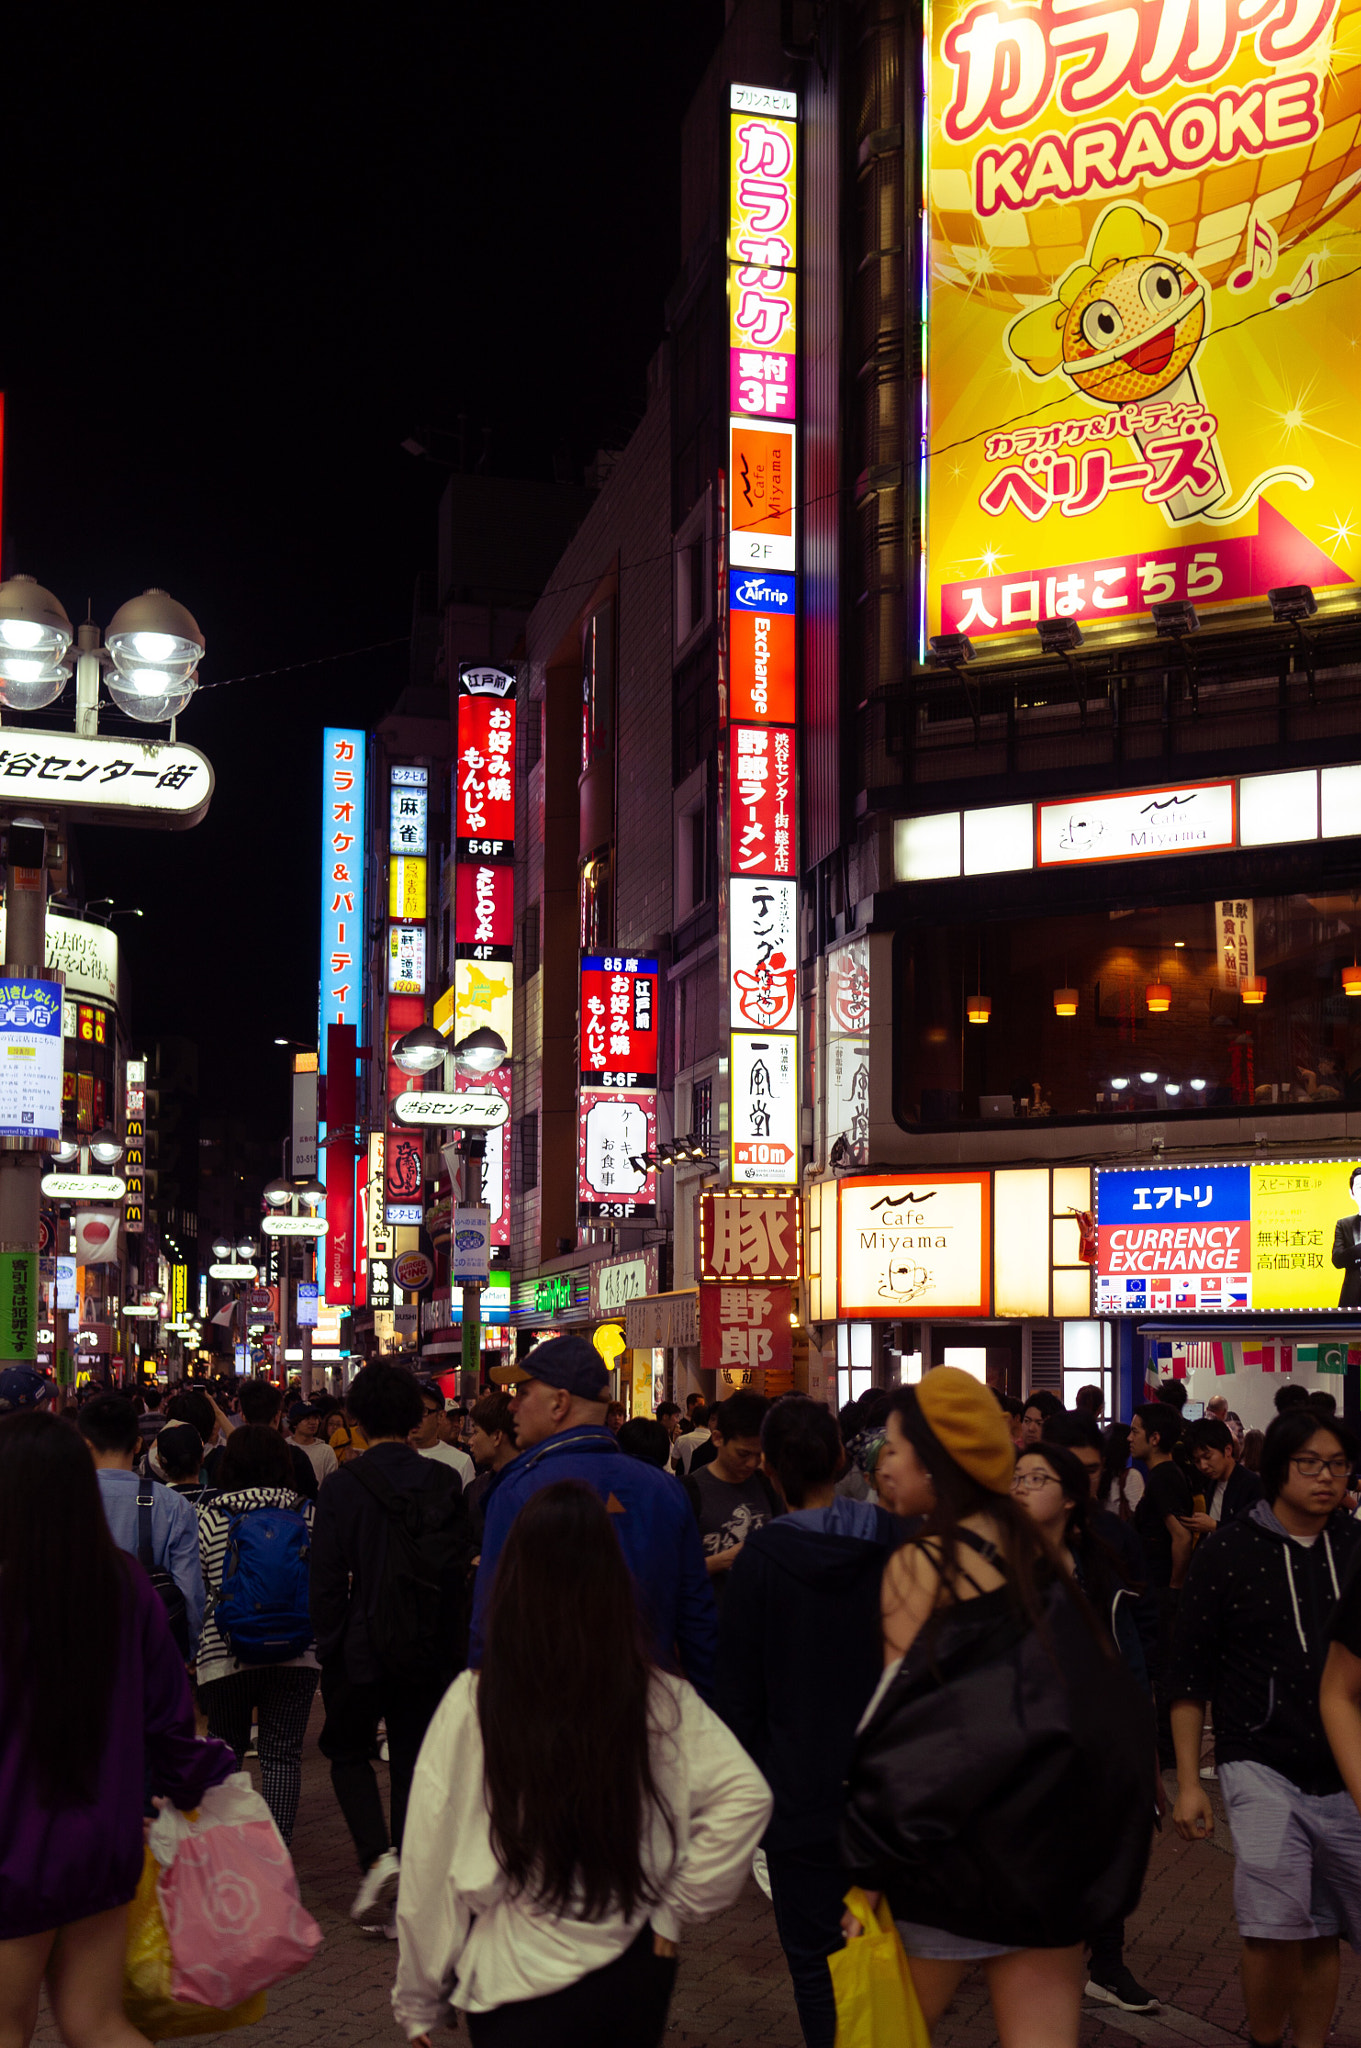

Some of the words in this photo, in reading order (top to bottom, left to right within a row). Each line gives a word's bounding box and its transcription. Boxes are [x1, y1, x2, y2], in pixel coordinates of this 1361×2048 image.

[735, 90, 793, 112] プリンスビル
[977, 73, 1318, 217] KARAOKE
[737, 123, 791, 345] カラオケ
[739, 352, 788, 382] 受付
[738, 383, 788, 413] 3F
[753, 464, 765, 499] Cafe
[768, 448, 782, 520] Miyama
[979, 414, 1218, 522] ベリーズ
[750, 542, 773, 559] 2F
[746, 584, 788, 606] AirTrip
[956, 552, 1225, 632] 入口はこちら
[751, 617, 771, 714] Exchange
[488, 707, 512, 801] お好み焼
[392, 770, 427, 782] センタービル
[463, 747, 486, 832] もんじゃ
[738, 729, 768, 871] 野郎ラーメン
[774, 732, 790, 873] 渋谷センター街総本店
[400, 797, 419, 843] 麻雀
[1151, 811, 1188, 825] Cafe
[1129, 828, 1207, 848] Miyama
[473, 945, 493, 960] 4F
[610, 975, 630, 1055] お好み焼
[636, 980, 650, 1028] 江戸前
[586, 996, 607, 1069] もんじゃ
[749, 1043, 780, 1136] 一風堂
[402, 1102, 503, 1116] 渋谷センター街
[619, 1109, 633, 1170] ケーキと
[601, 1138, 615, 1187] お食事
[386, 1209, 422, 1220] センタービル
[1132, 1185, 1213, 1210] エアトリ
[881, 1210, 925, 1226] Cafe
[710, 1199, 790, 1275] 豚
[860, 1232, 948, 1252] Miyama
[1109, 1227, 1240, 1250] CURRENCY
[1257, 1229, 1324, 1247] 無料査定
[333, 1252, 342, 1288] mobile
[398, 1260, 427, 1273] BURGER
[400, 1267, 428, 1283] KING
[1109, 1249, 1240, 1271] EXCHANGE
[1257, 1252, 1324, 1270] 高価買取
[11, 1260, 28, 1352] 客引きは犯罪です
[371, 1297, 390, 1306] B1F
[534, 1277, 571, 1318] FamilyMart
[719, 1287, 774, 1367] 野郎
